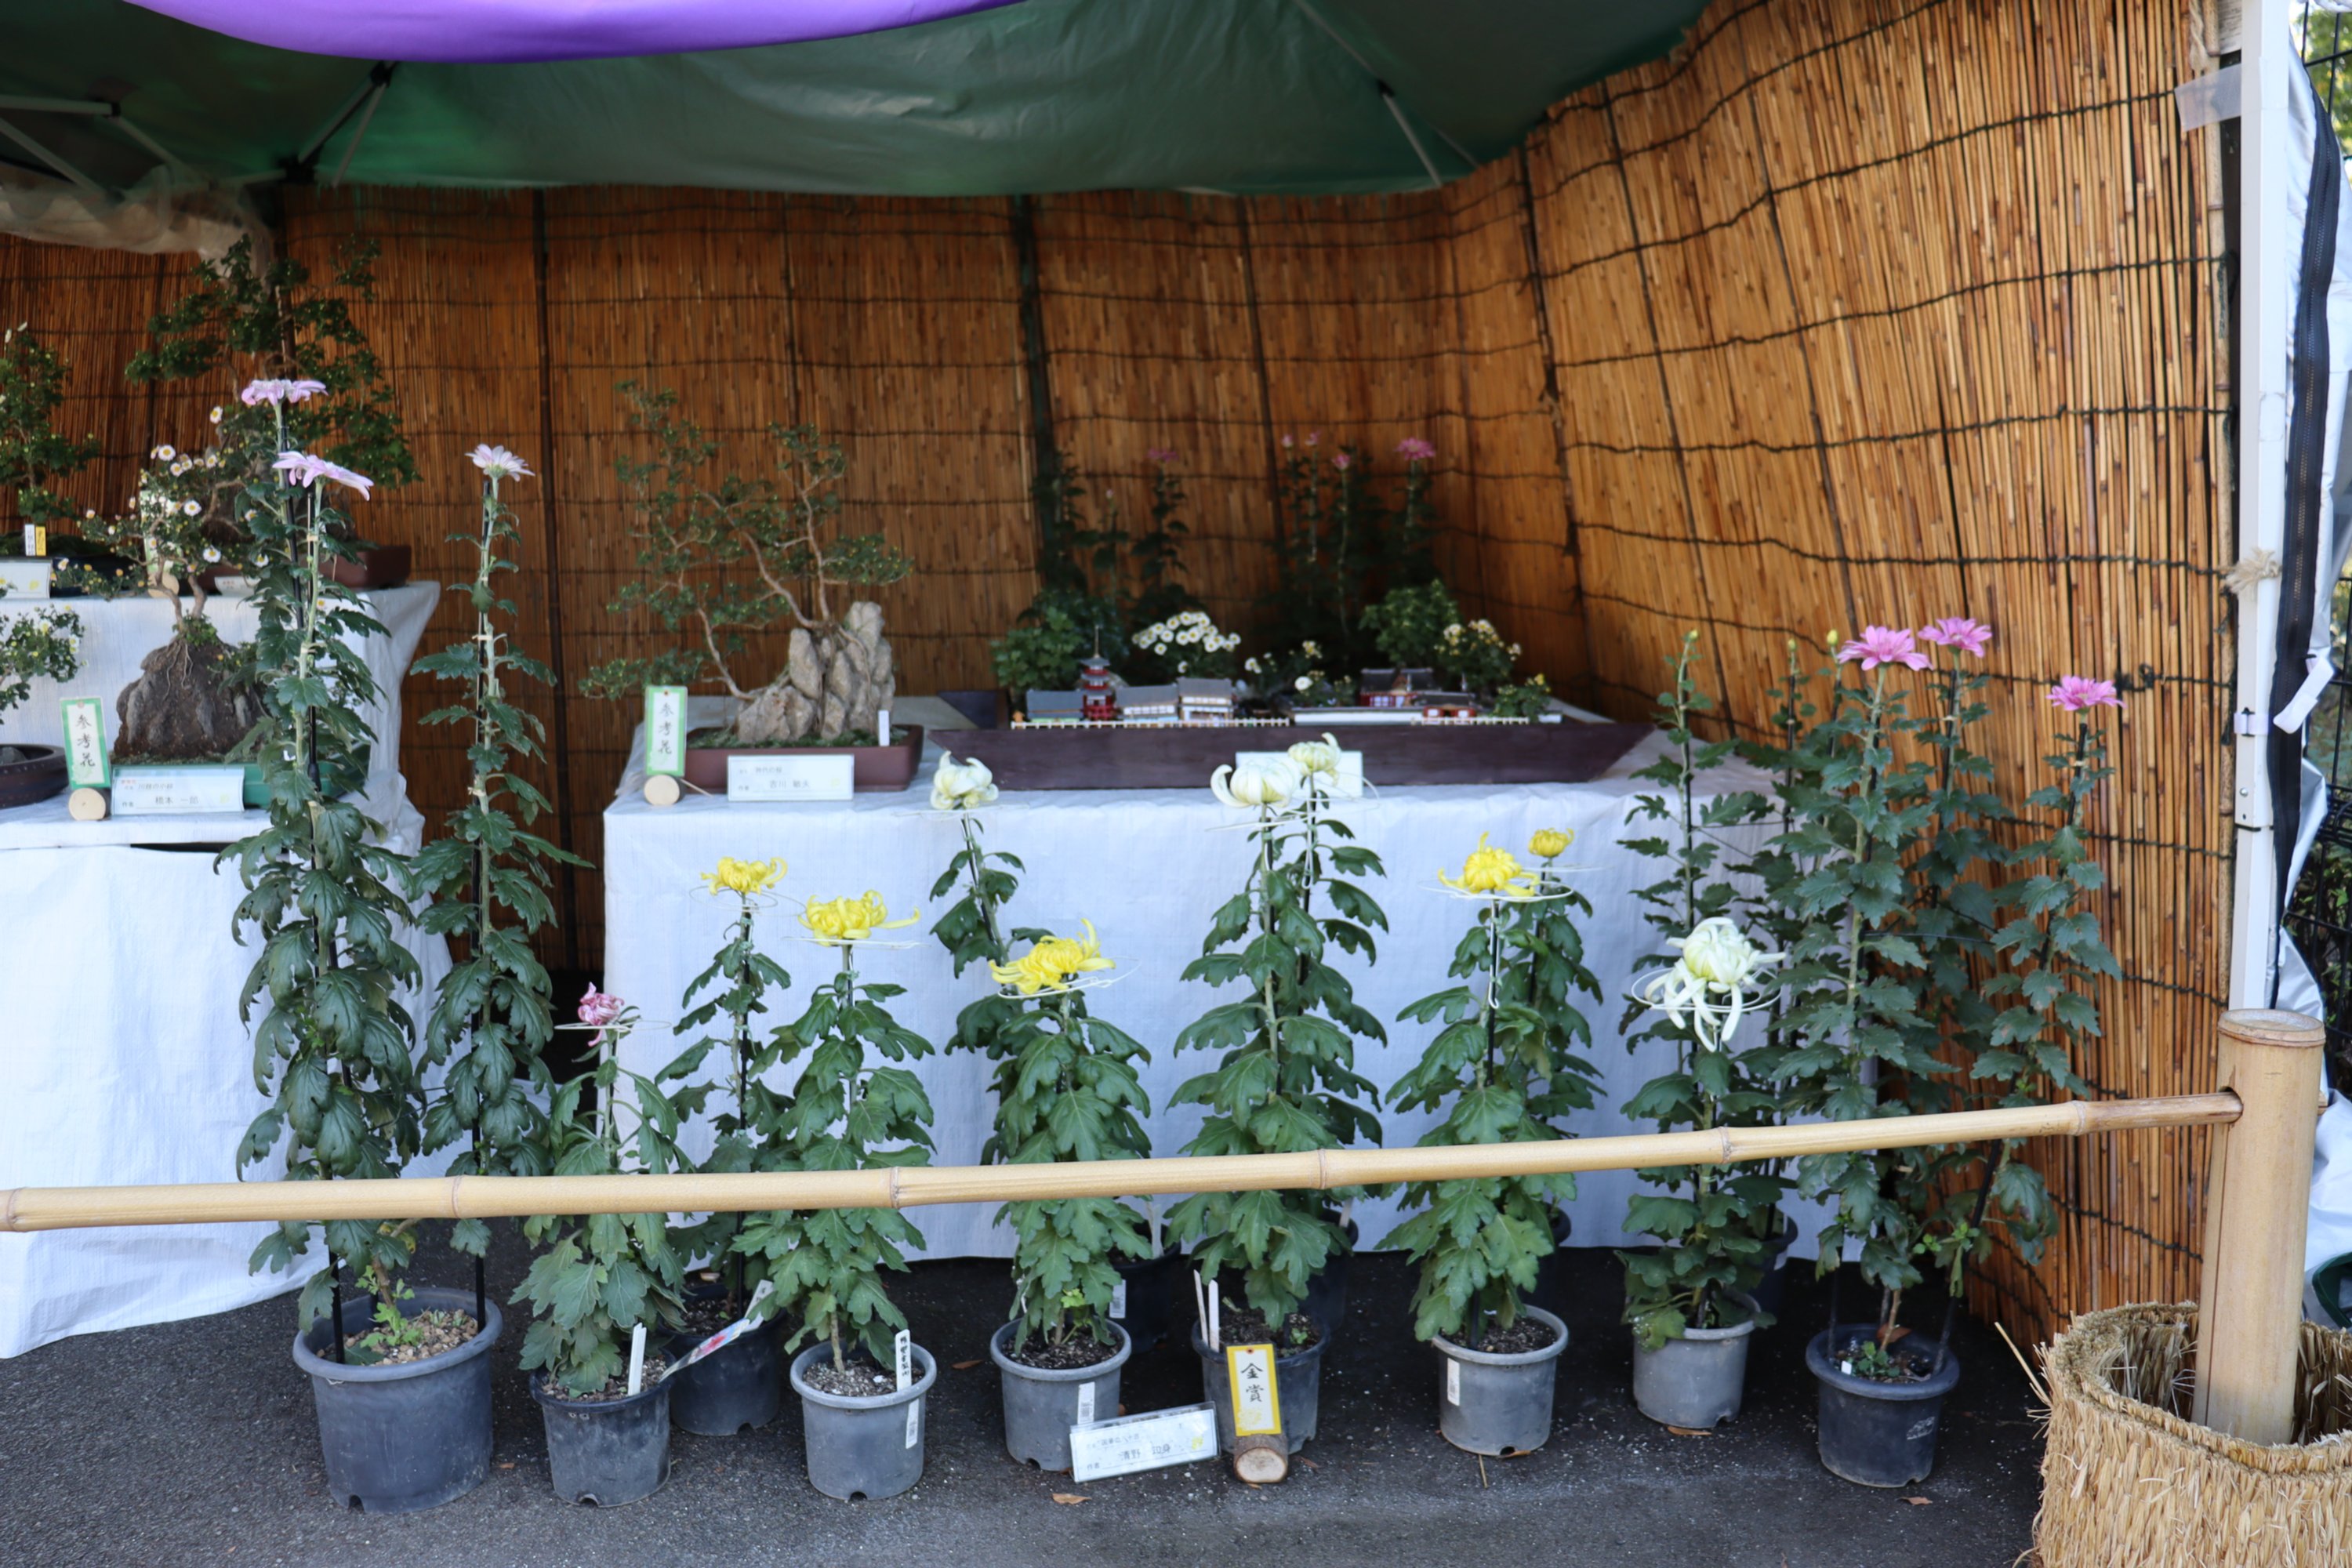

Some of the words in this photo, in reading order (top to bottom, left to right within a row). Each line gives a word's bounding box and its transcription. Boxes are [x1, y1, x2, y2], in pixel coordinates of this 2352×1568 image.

[76, 714, 95, 768] 参考花
[658, 702, 674, 755] 参考花
[1240, 1363, 1264, 1403] 金賞
